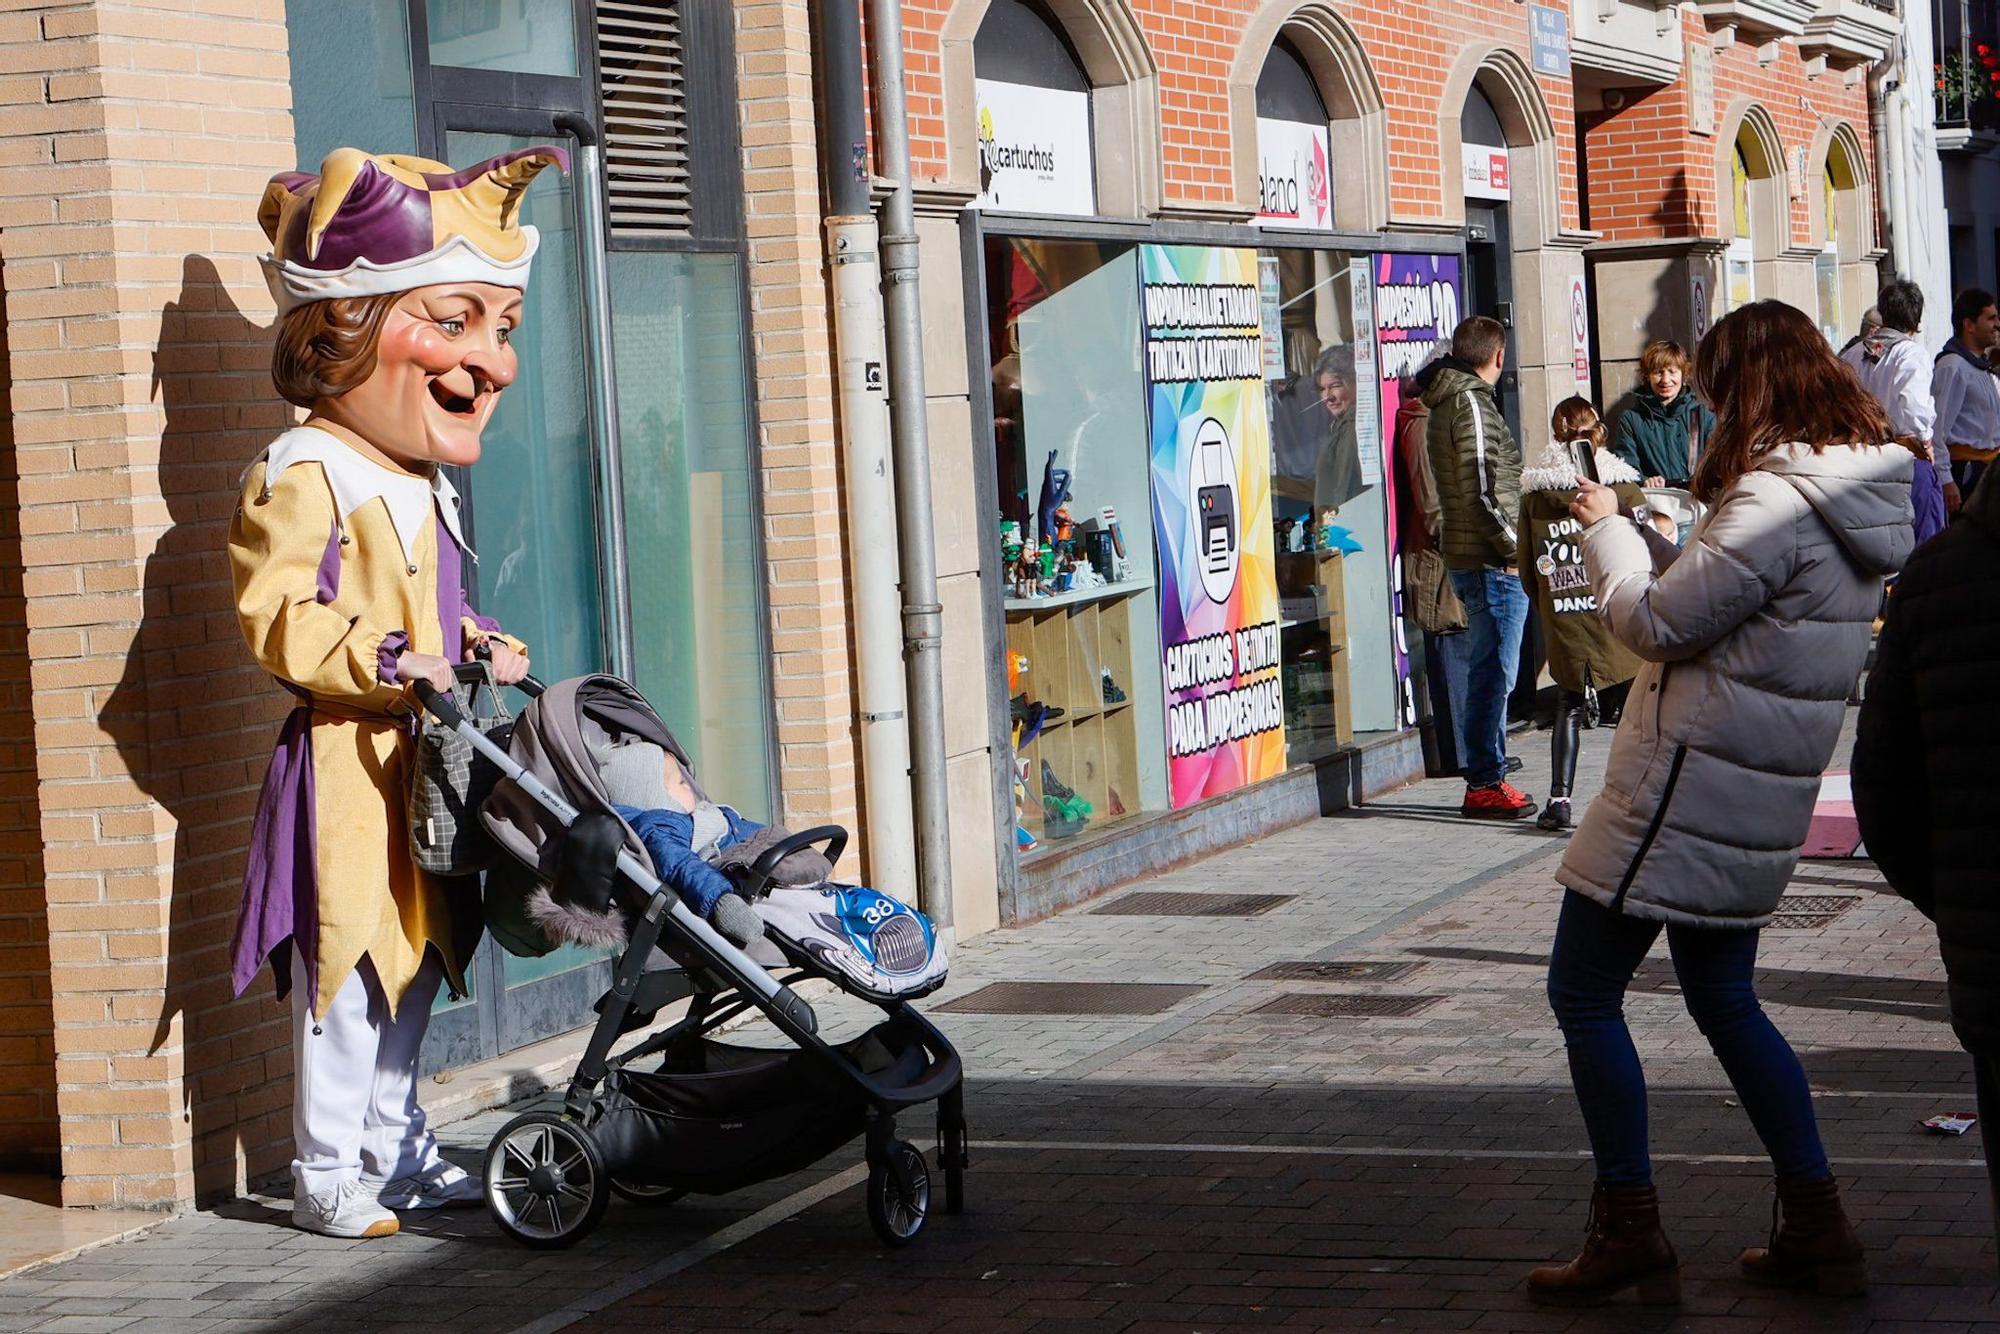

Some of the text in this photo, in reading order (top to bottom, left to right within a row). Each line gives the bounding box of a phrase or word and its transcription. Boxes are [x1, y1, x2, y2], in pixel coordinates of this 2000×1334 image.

[1145, 282, 1259, 329] INPRIMAGAILUETARAKO
[1376, 271, 1433, 331] IMPRESIÓN
[1148, 336, 1199, 384] TINTAZKO
[1198, 335, 1262, 382] KARTUTXOAK
[1548, 518, 1583, 539] DON
[1551, 567, 1587, 588] WAN
[1553, 595, 1598, 613] DANC
[1167, 620, 1279, 694] CARTUCHOS DE TINTA
[1169, 676, 1282, 759] PARA IMPRESORAS
